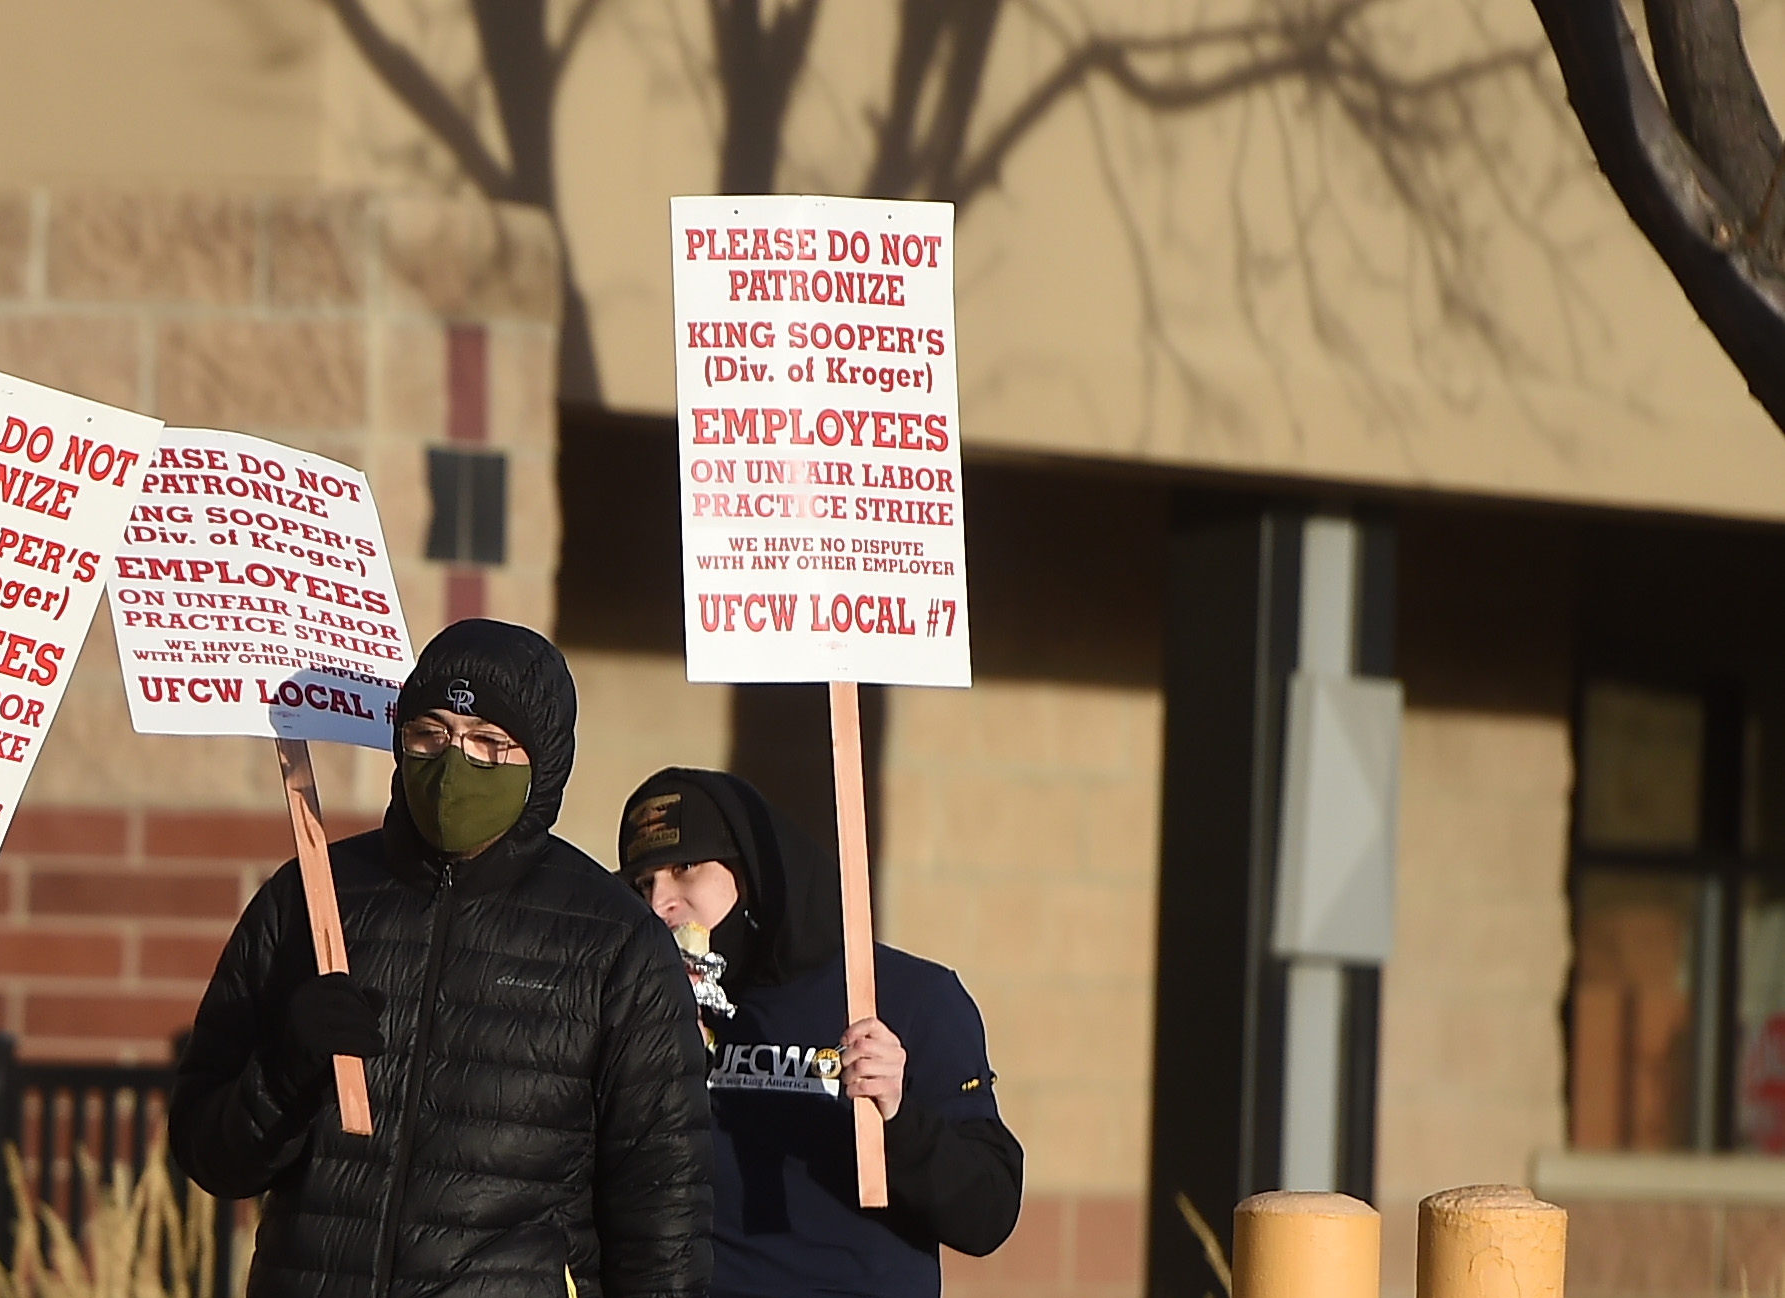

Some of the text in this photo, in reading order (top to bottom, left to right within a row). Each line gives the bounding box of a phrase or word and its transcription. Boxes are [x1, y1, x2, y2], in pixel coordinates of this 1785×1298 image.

[686, 228, 940, 267] PLEASE DO NOT
[730, 270, 904, 306] PATRONIZE
[688, 322, 943, 355] KING SOOPER'S
[706, 356, 931, 393] (Div. of Kroger)
[693, 409, 947, 451] EMPLOYEES
[60, 436, 138, 486] NOT
[238, 453, 284, 481] DO
[296, 468, 360, 502] NOT
[692, 460, 956, 493] ON UNFAIR LABOR
[141, 473, 329, 519] PATRONIZE
[694, 494, 952, 525] PRACTICE STRIKE
[124, 525, 365, 576] (Div. of Kroger)
[206, 508, 375, 556] SOOPER'S
[729, 538, 923, 556] WE HAVE NO DISPUTE
[117, 557, 389, 614] EMPLOYEES
[697, 556, 954, 575] WITH ANY OTHER EMPLOYER
[119, 590, 400, 640] ON UNFAIR LABOR
[699, 594, 955, 637] UFCW LOCAL #7
[123, 611, 402, 661] PRACTICE STRIKE
[134, 651, 183, 661] WITH
[192, 654, 230, 662] ANY
[238, 654, 303, 669] OTHER
[165, 640, 375, 674] WE HAVE NO DISPUTE
[139, 677, 242, 702] UFCW
[255, 678, 375, 720] LOCAL
[765, 1077, 810, 1090] America
